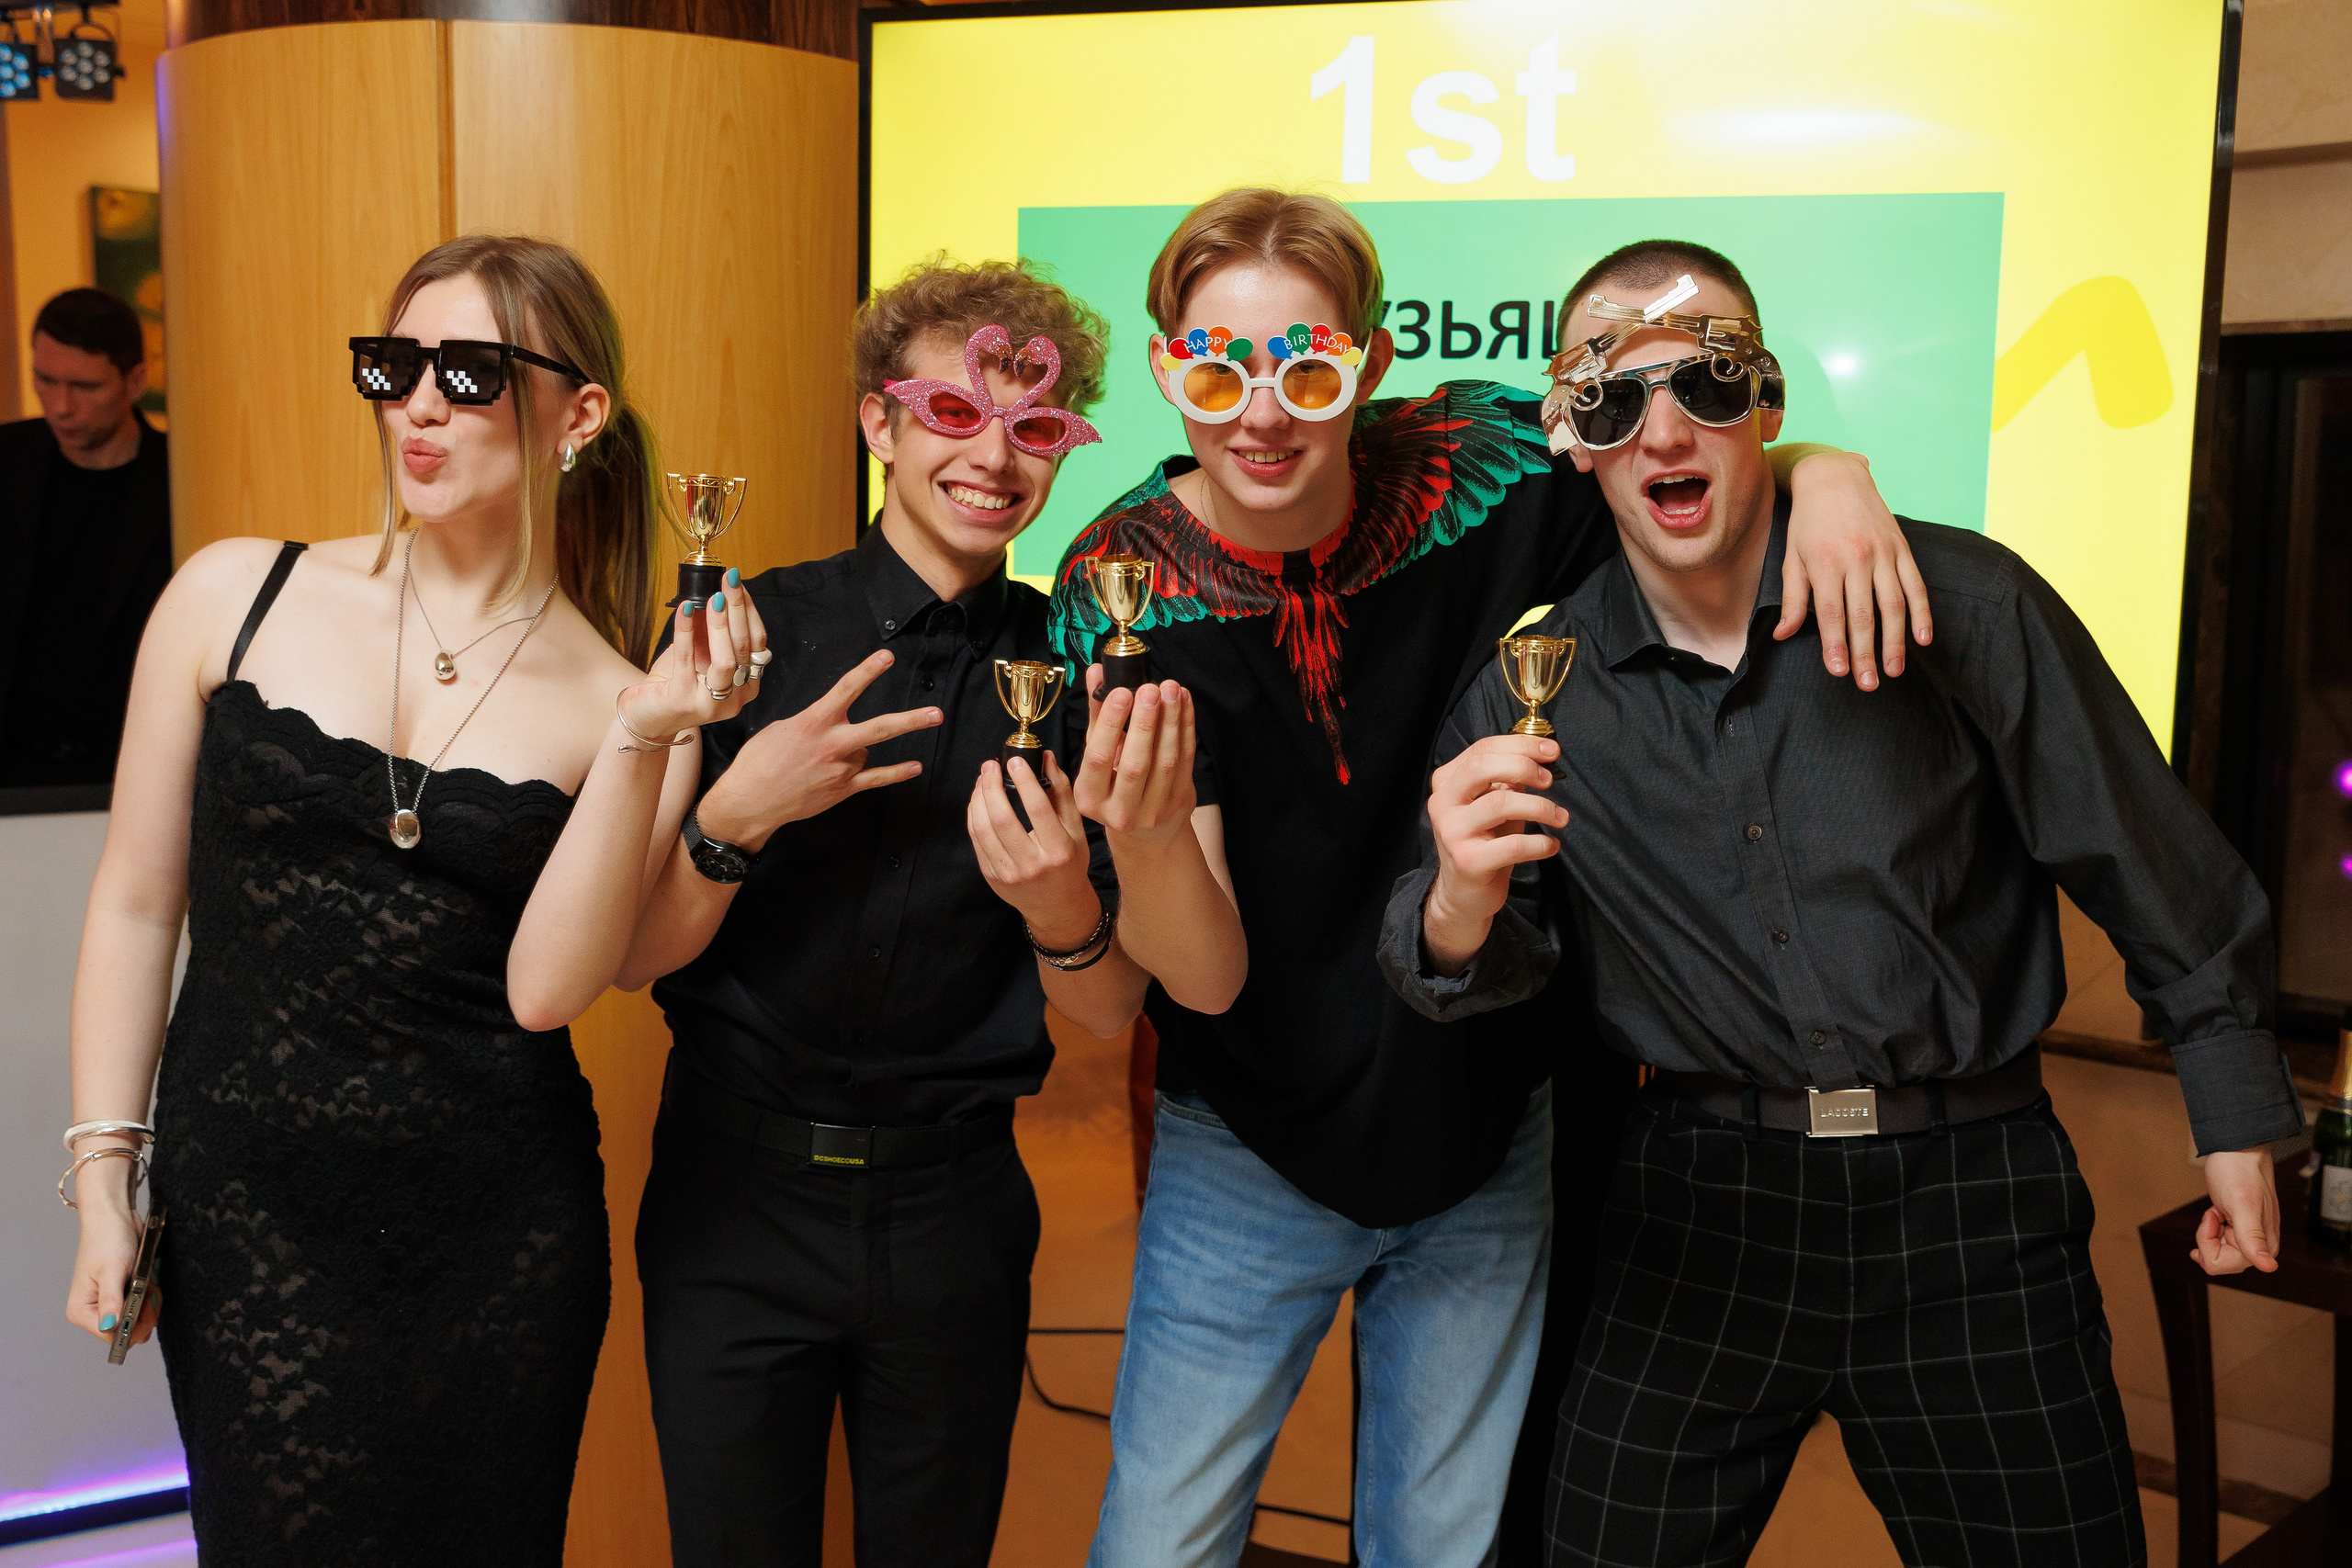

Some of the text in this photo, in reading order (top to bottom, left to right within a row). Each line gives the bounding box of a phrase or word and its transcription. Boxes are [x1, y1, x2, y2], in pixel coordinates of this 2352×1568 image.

[1310, 33, 1577, 184] 1st
[1183, 333, 1349, 354] HAPPY BIRTHDAY
[1820, 1108, 1869, 1117] LACOSTE
